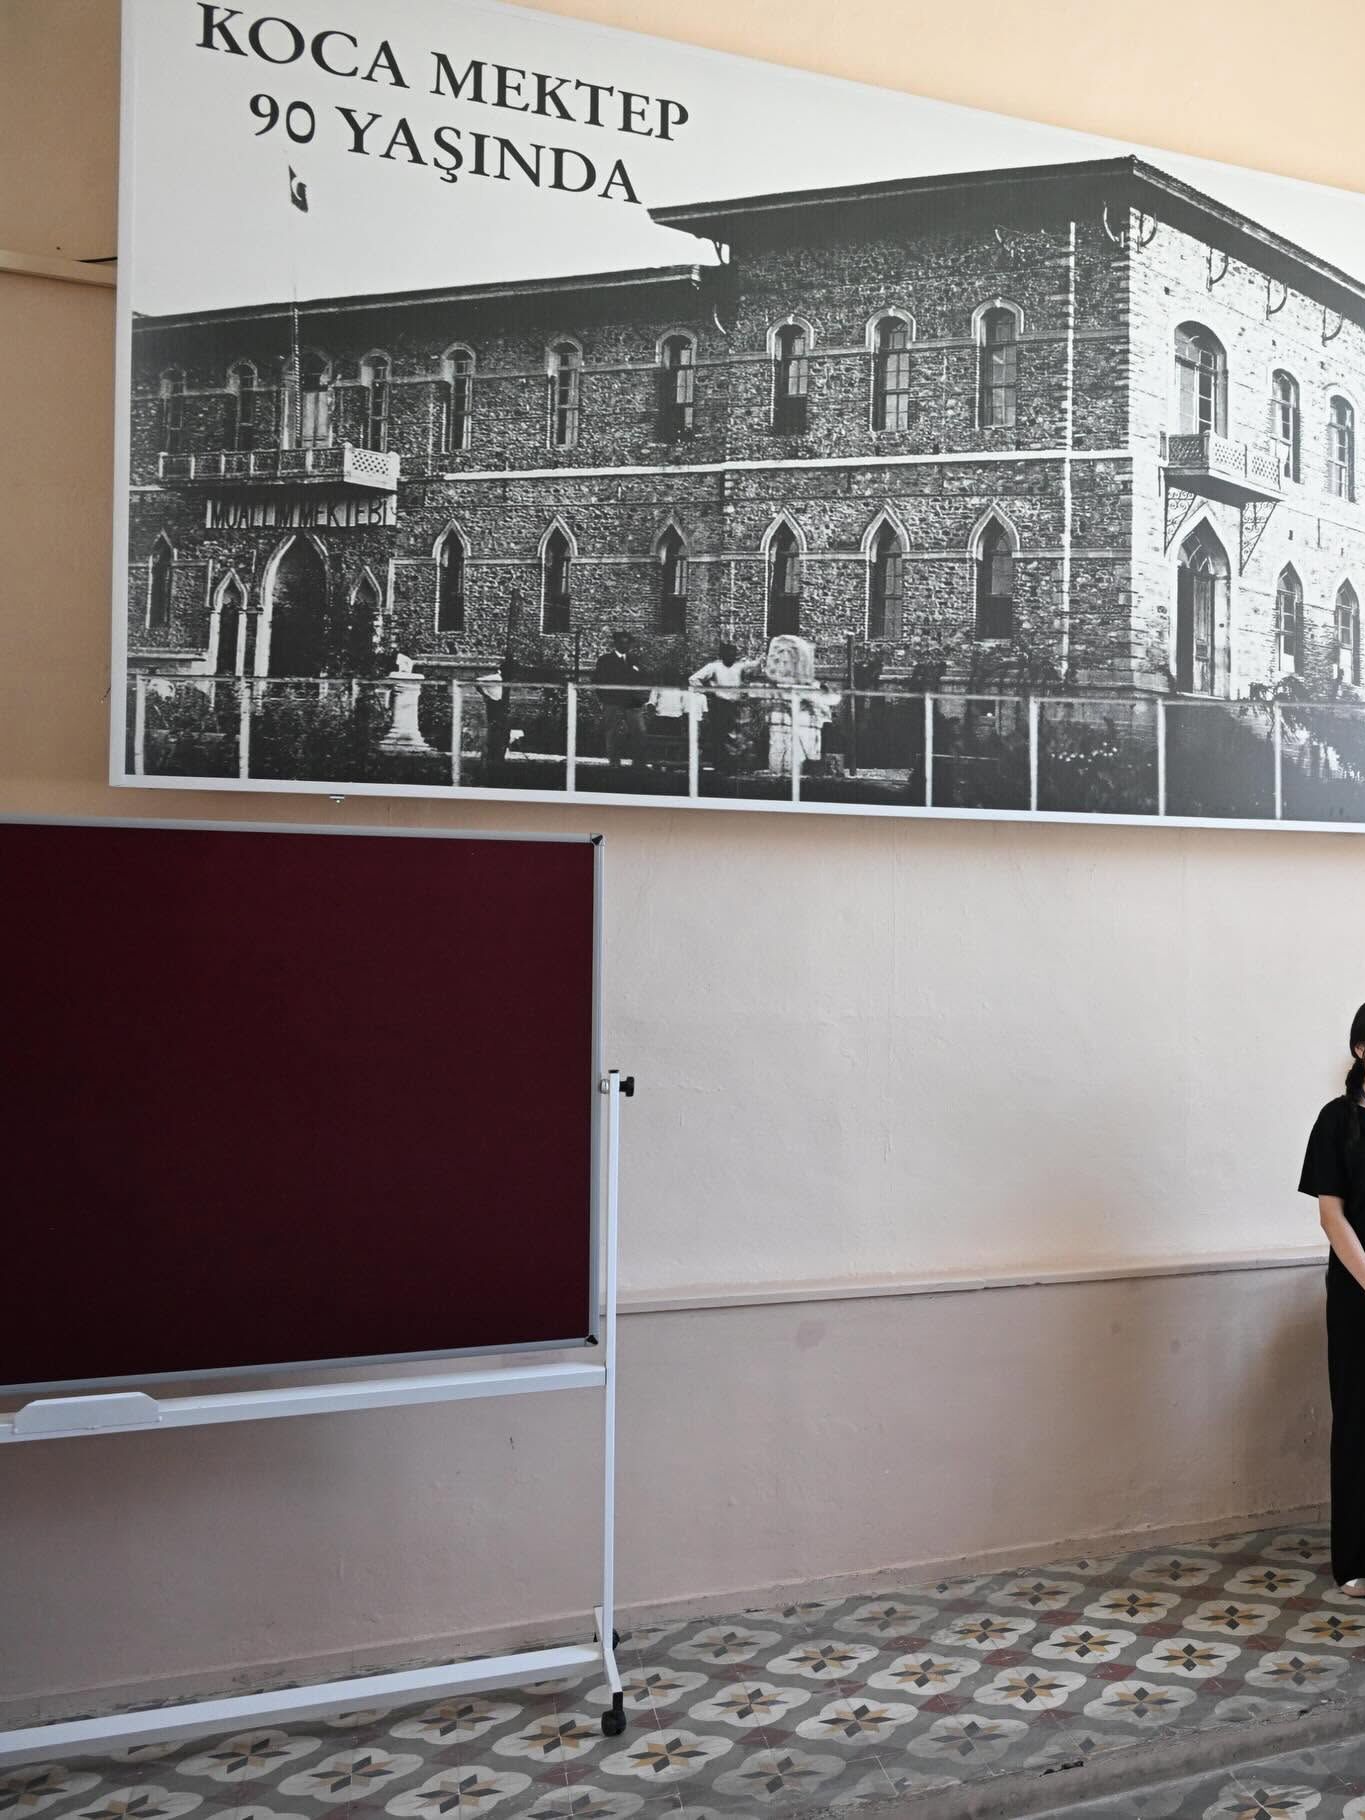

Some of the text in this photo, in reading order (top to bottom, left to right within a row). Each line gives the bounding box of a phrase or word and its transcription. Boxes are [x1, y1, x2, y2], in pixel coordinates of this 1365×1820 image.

[196, 2, 690, 142] KOCA MEKTEP
[249, 93, 643, 206] 90 YAŞINDA
